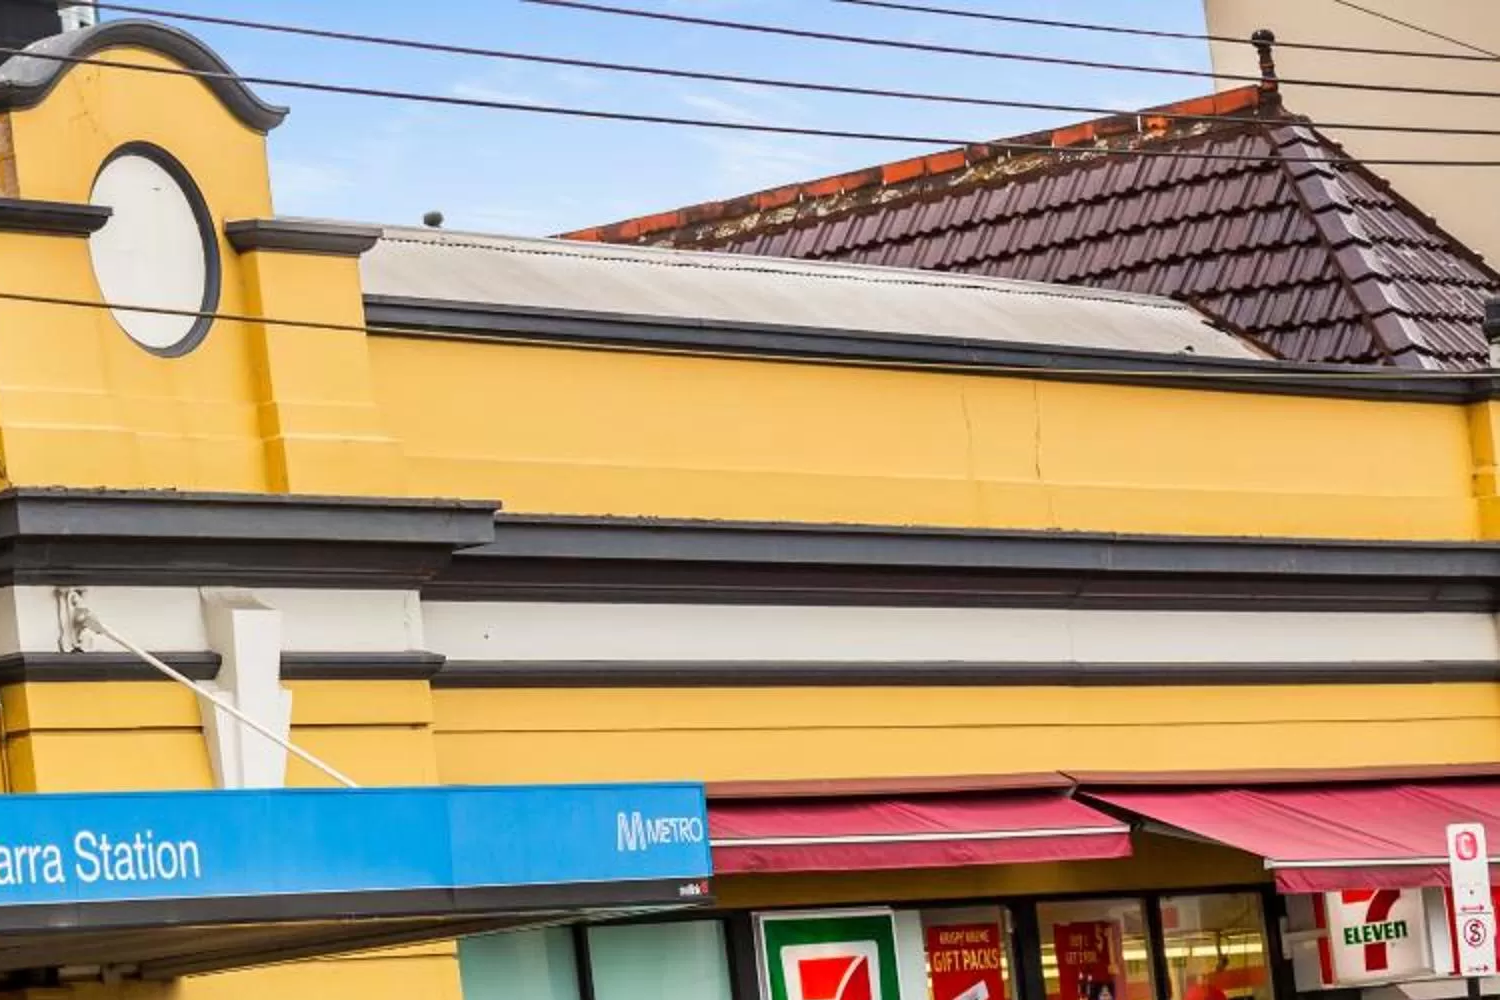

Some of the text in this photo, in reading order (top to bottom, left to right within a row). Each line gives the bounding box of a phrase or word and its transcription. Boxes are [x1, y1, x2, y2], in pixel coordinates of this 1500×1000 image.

[647, 817, 704, 844] METRO
[73, 829, 201, 884] Station
[1341, 889, 1401, 971] 7
[933, 948, 999, 972] GIFT PACKS
